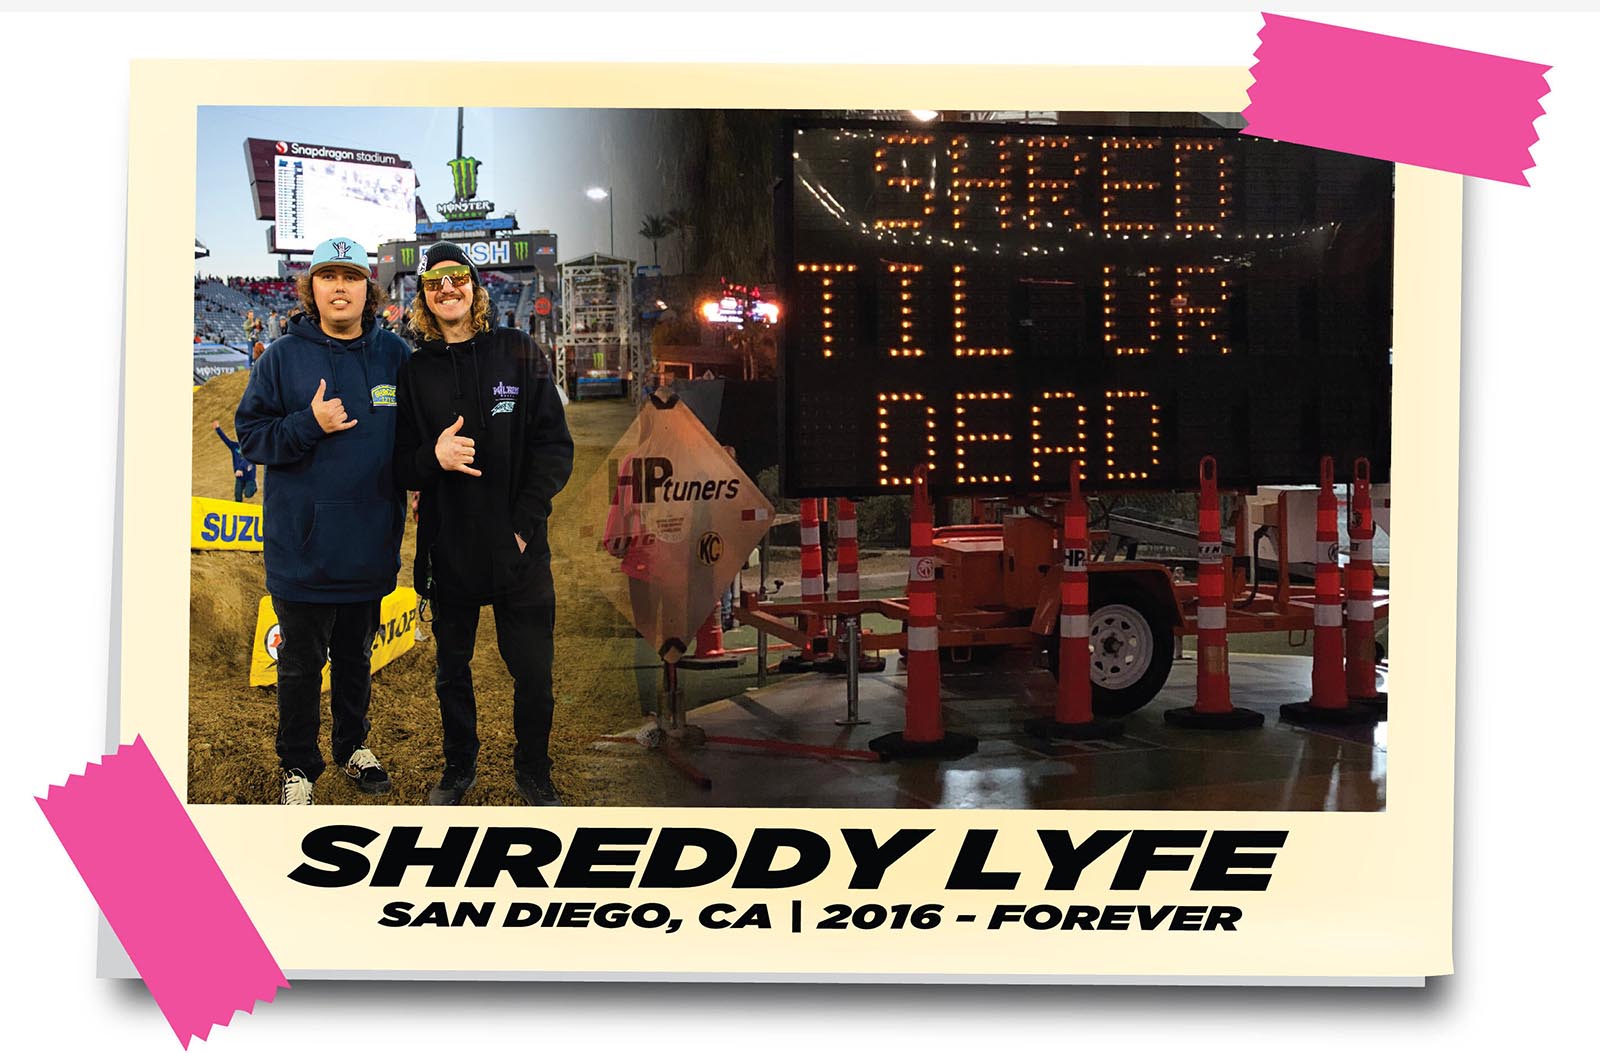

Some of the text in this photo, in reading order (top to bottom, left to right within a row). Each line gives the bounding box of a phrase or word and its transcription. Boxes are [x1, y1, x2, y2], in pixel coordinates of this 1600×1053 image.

[291, 142, 396, 165] Snapdragon stadium
[873, 136, 1230, 231] SHRED
[437, 199, 491, 213] MONSTER
[797, 263, 1232, 358] TIL UR
[196, 365, 235, 377] MONSTER
[877, 390, 1160, 485] DEAD
[700, 534, 721, 564] KC
